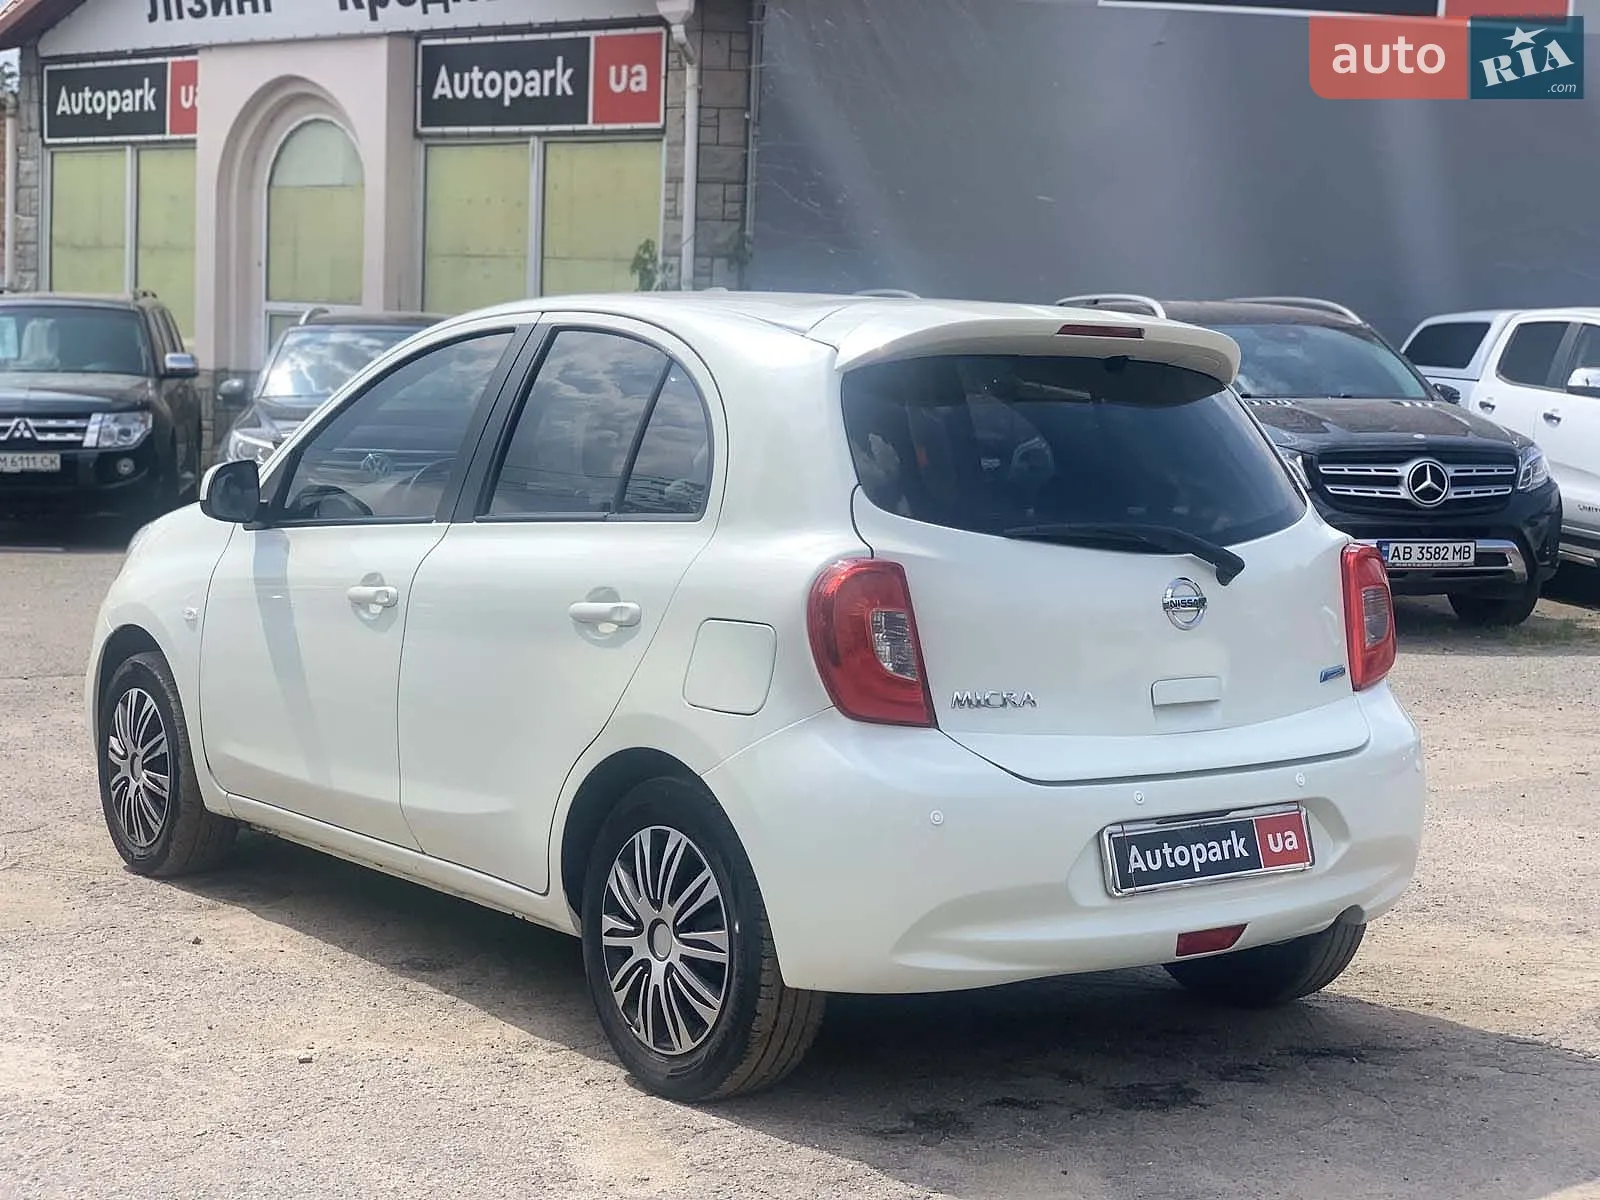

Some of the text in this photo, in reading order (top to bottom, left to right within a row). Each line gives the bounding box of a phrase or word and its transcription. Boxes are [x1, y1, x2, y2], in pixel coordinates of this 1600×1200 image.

[432, 56, 648, 107] Autopark ua
[56, 77, 197, 120] Autopark u
[1391, 545, 1471, 561] AB 3582 MB
[1169, 598, 1206, 609] NISSAN
[951, 691, 1037, 709] MICRA
[1127, 830, 1299, 873] Autopark ua
